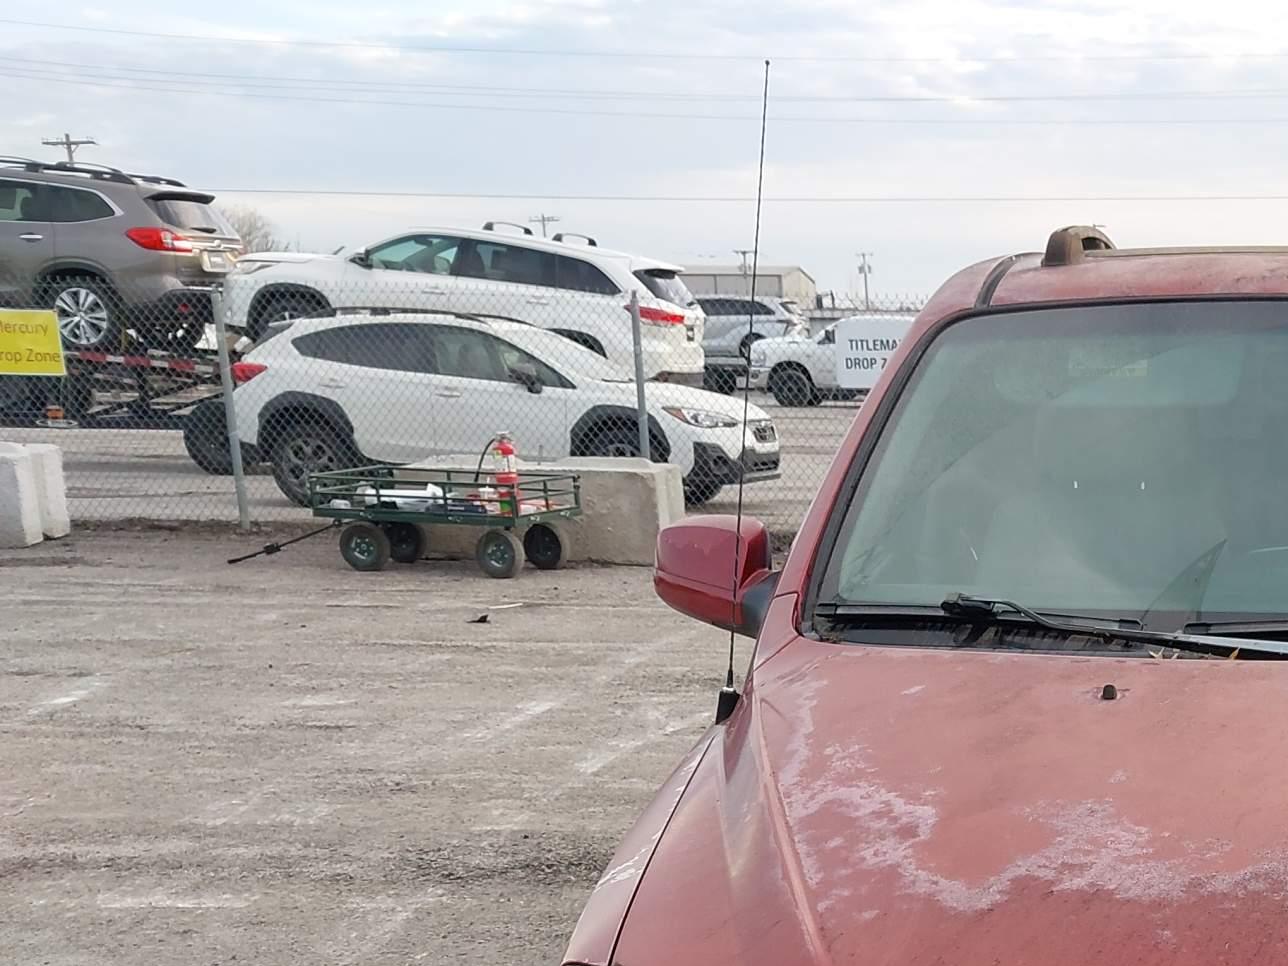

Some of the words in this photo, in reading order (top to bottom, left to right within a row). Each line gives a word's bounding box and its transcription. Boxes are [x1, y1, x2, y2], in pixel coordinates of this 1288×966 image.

[847, 339, 902, 351] TITLEMA
[25, 348, 61, 362] Zone
[845, 357, 877, 370] DROP
